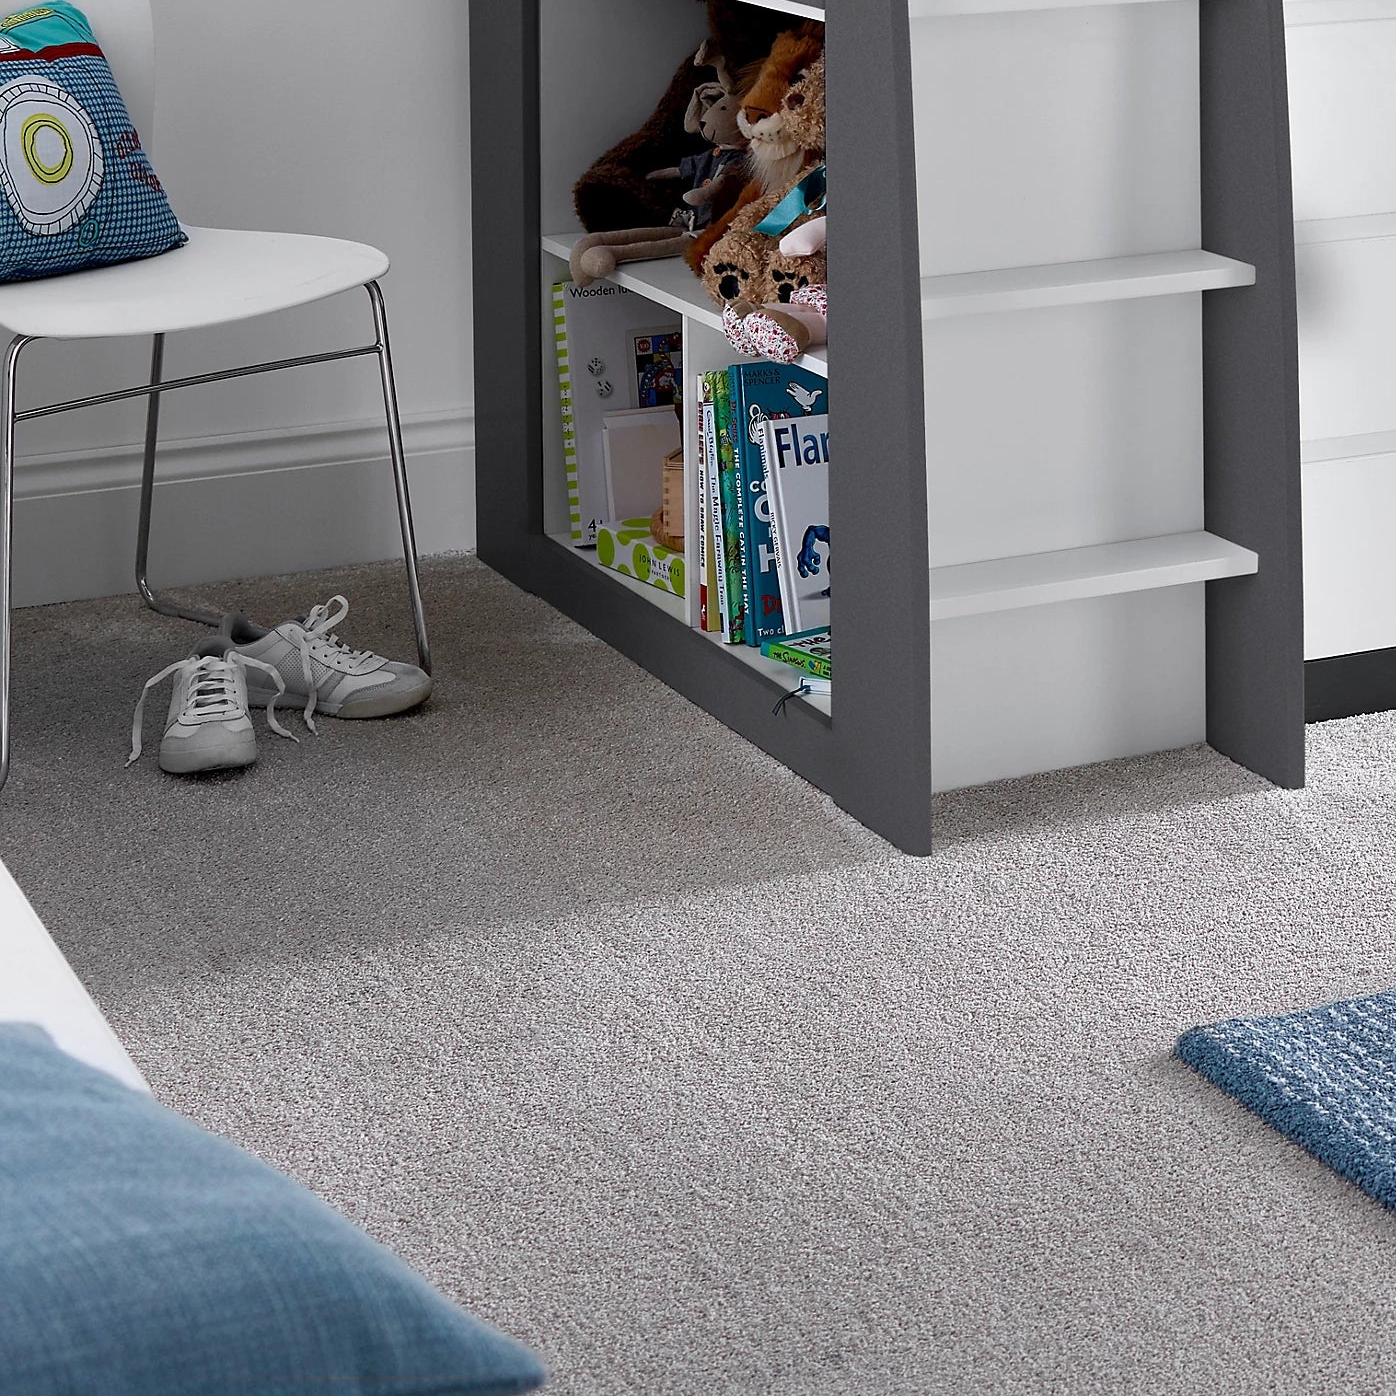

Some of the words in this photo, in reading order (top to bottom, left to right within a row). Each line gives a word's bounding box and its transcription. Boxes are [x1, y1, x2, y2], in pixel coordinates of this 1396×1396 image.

[570, 285, 616, 298] Wooden
[735, 472, 745, 528] COMPLETE
[741, 555, 747, 566] IN
[640, 553, 657, 567] JOHN
[658, 561, 681, 577] LEWIS
[757, 628, 775, 637] Two
